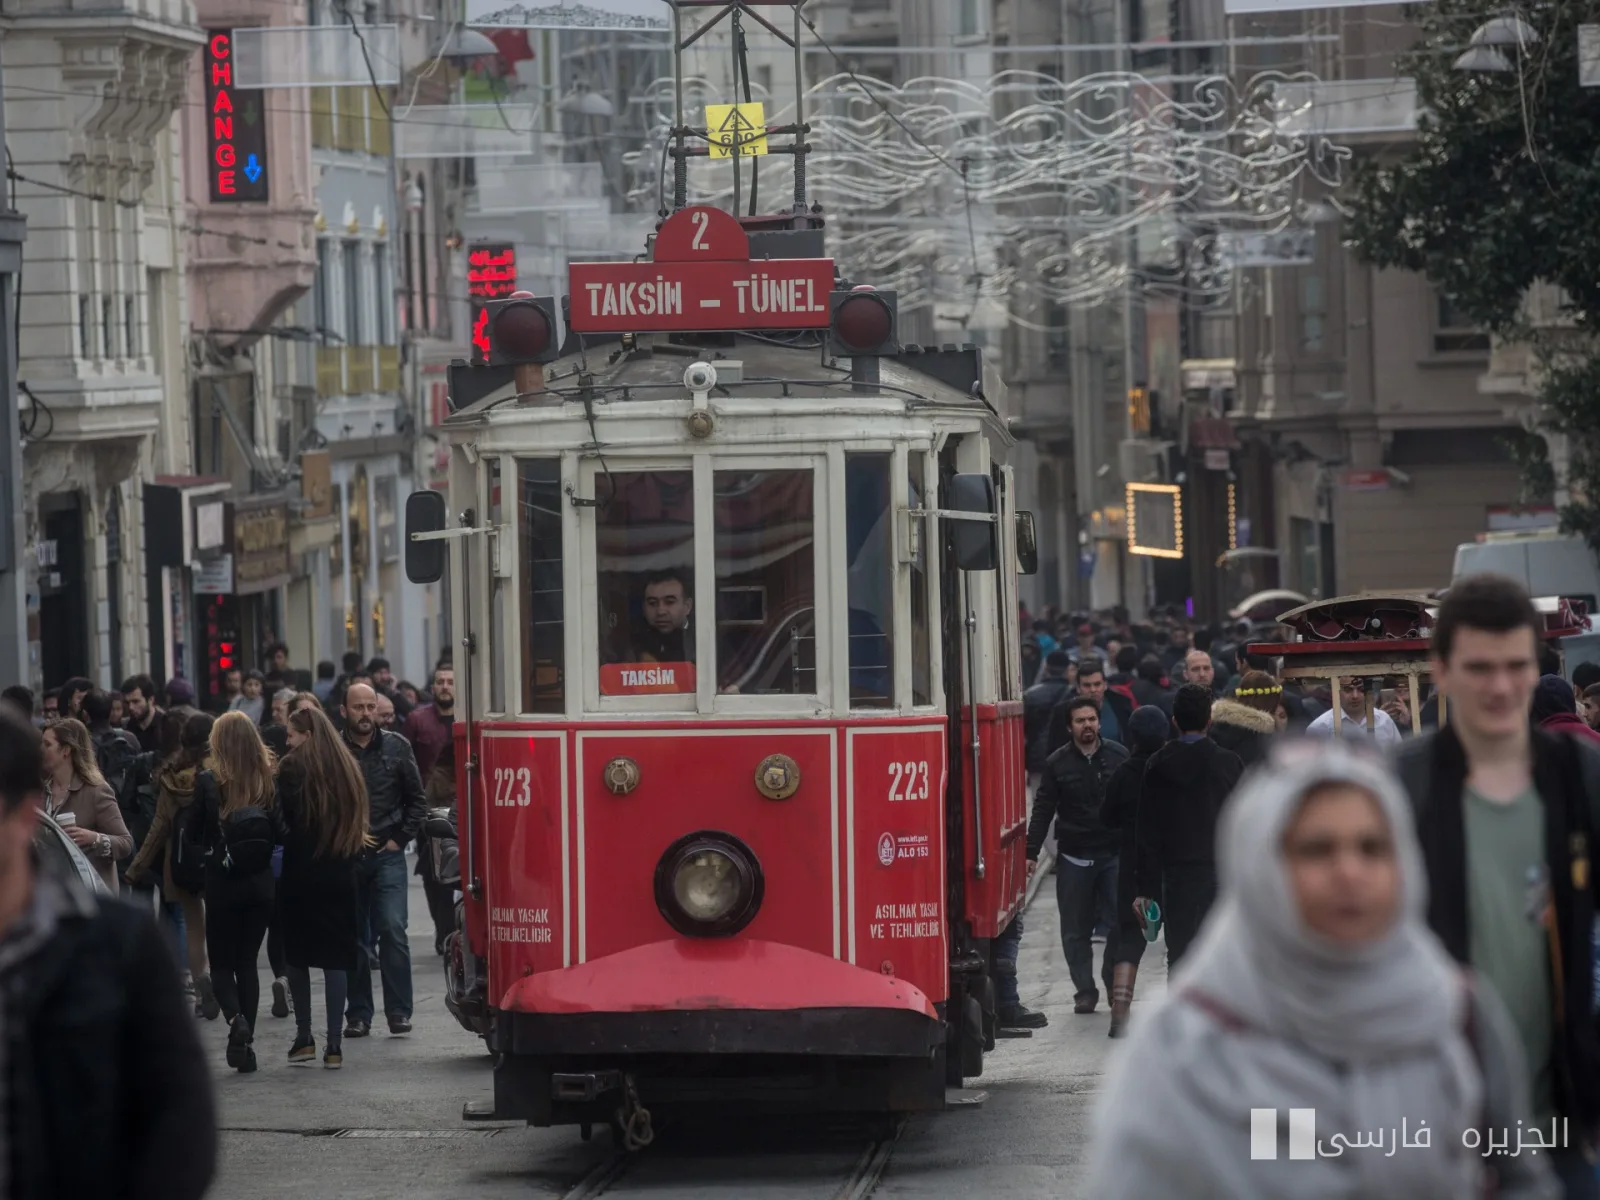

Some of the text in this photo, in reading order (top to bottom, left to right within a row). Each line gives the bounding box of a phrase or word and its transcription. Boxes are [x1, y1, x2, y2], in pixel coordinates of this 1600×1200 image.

[211, 34, 236, 194] CHANGE
[691, 211, 709, 250] 2
[585, 275, 682, 316] TAKSİM
[733, 273, 825, 314] TÜNEL
[620, 667, 675, 687] TAKSİM
[494, 767, 531, 807] 223
[888, 760, 929, 801] 223
[897, 846, 929, 858] ALO 153
[517, 908, 549, 923] YASAK
[869, 923, 885, 939] VE
